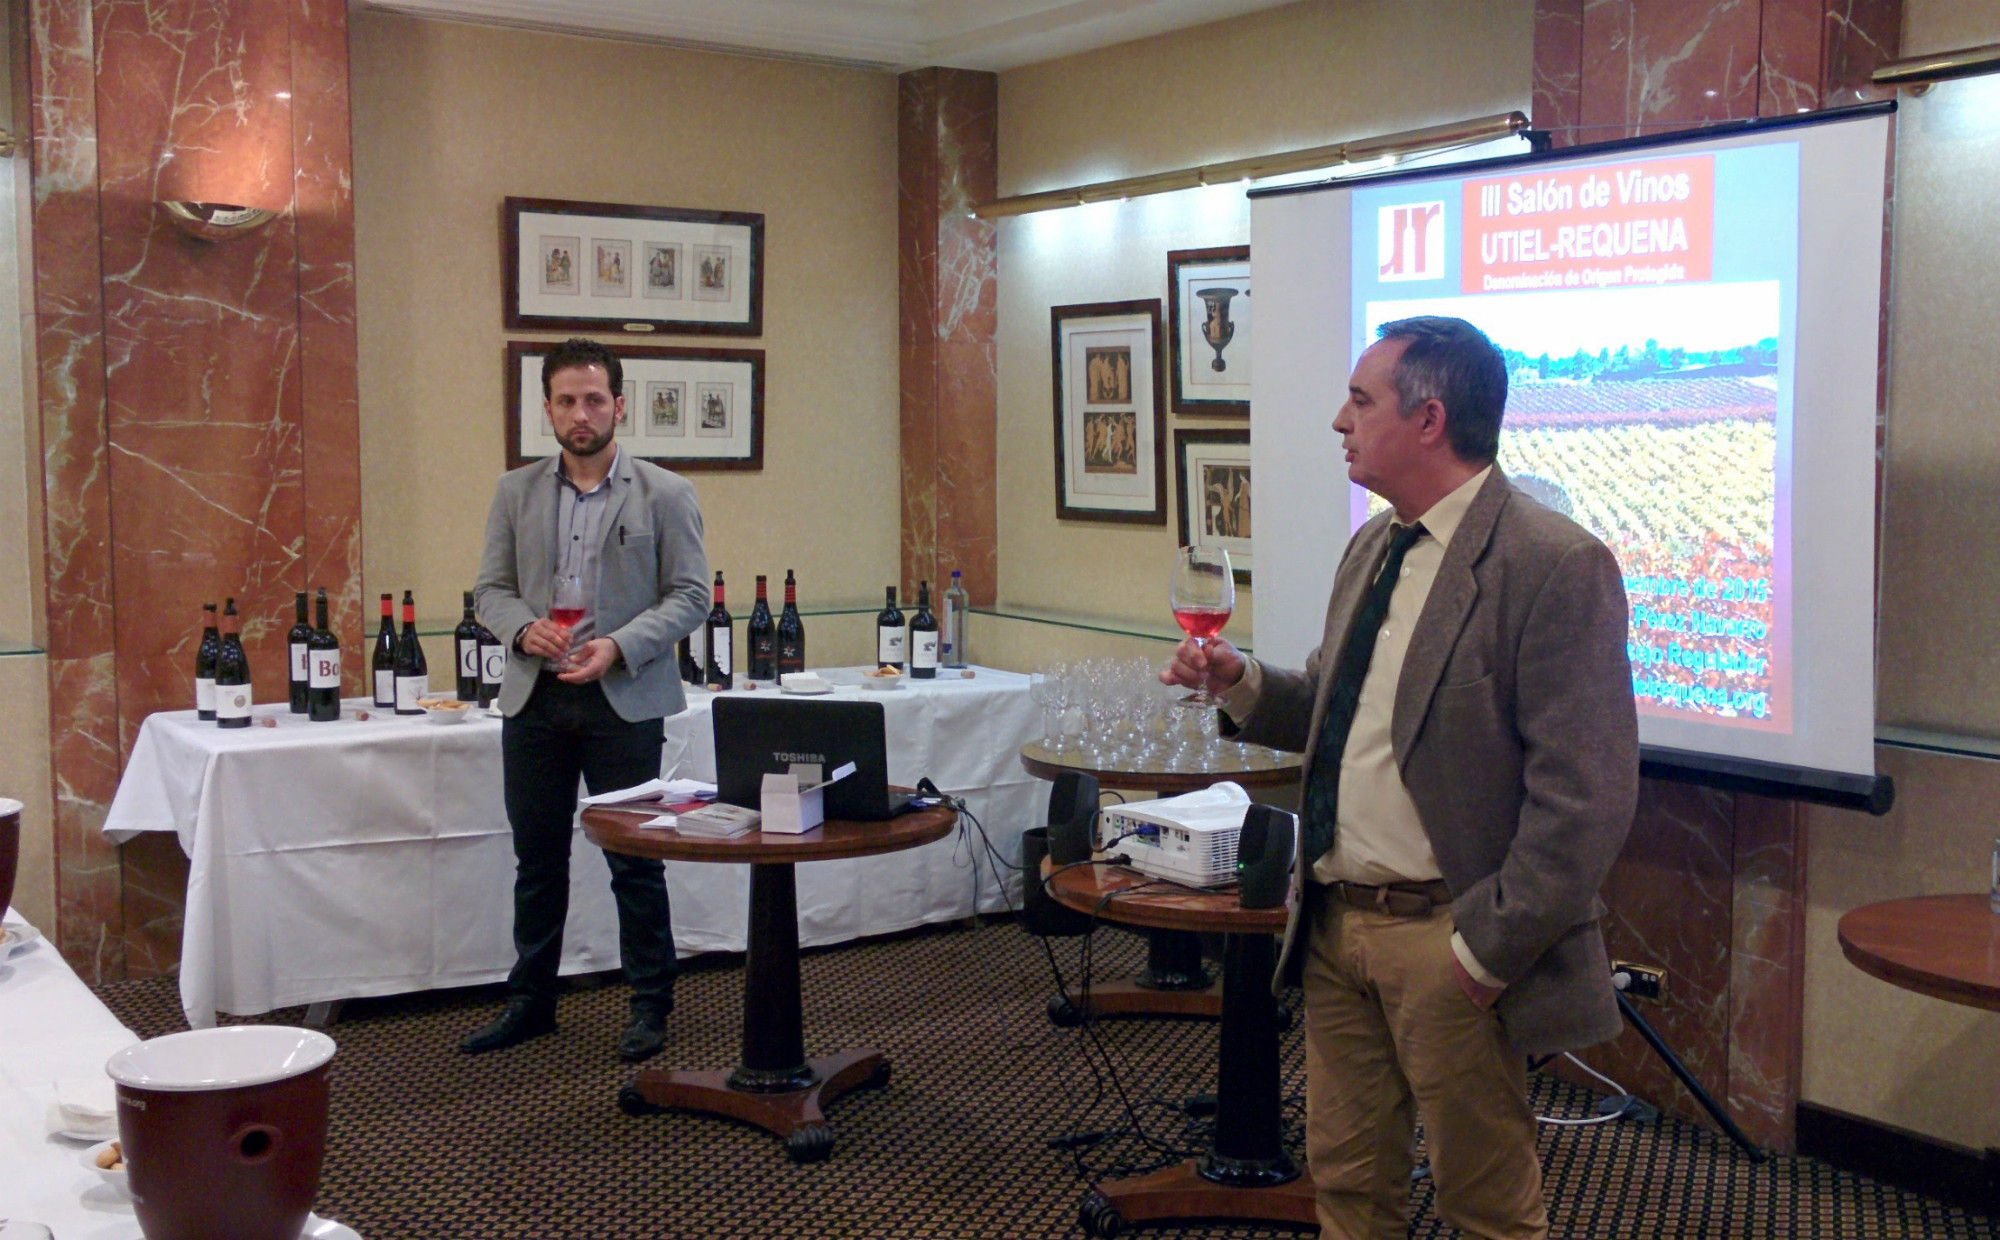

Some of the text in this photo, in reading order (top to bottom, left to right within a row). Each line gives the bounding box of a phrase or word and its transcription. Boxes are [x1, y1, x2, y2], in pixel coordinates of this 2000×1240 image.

[1480, 169, 1691, 218] III Salón de Vinos
[1481, 217, 1688, 264] UTIEL-REQUENA
[1483, 263, 1685, 291] Denominación de Origen Protegida
[1693, 576, 1717, 600] de
[1722, 578, 1767, 603] 2015
[1633, 604, 1767, 640] Pérez Navarro
[1668, 642, 1768, 677] Regulador
[773, 752, 826, 764] TOSHIBA
